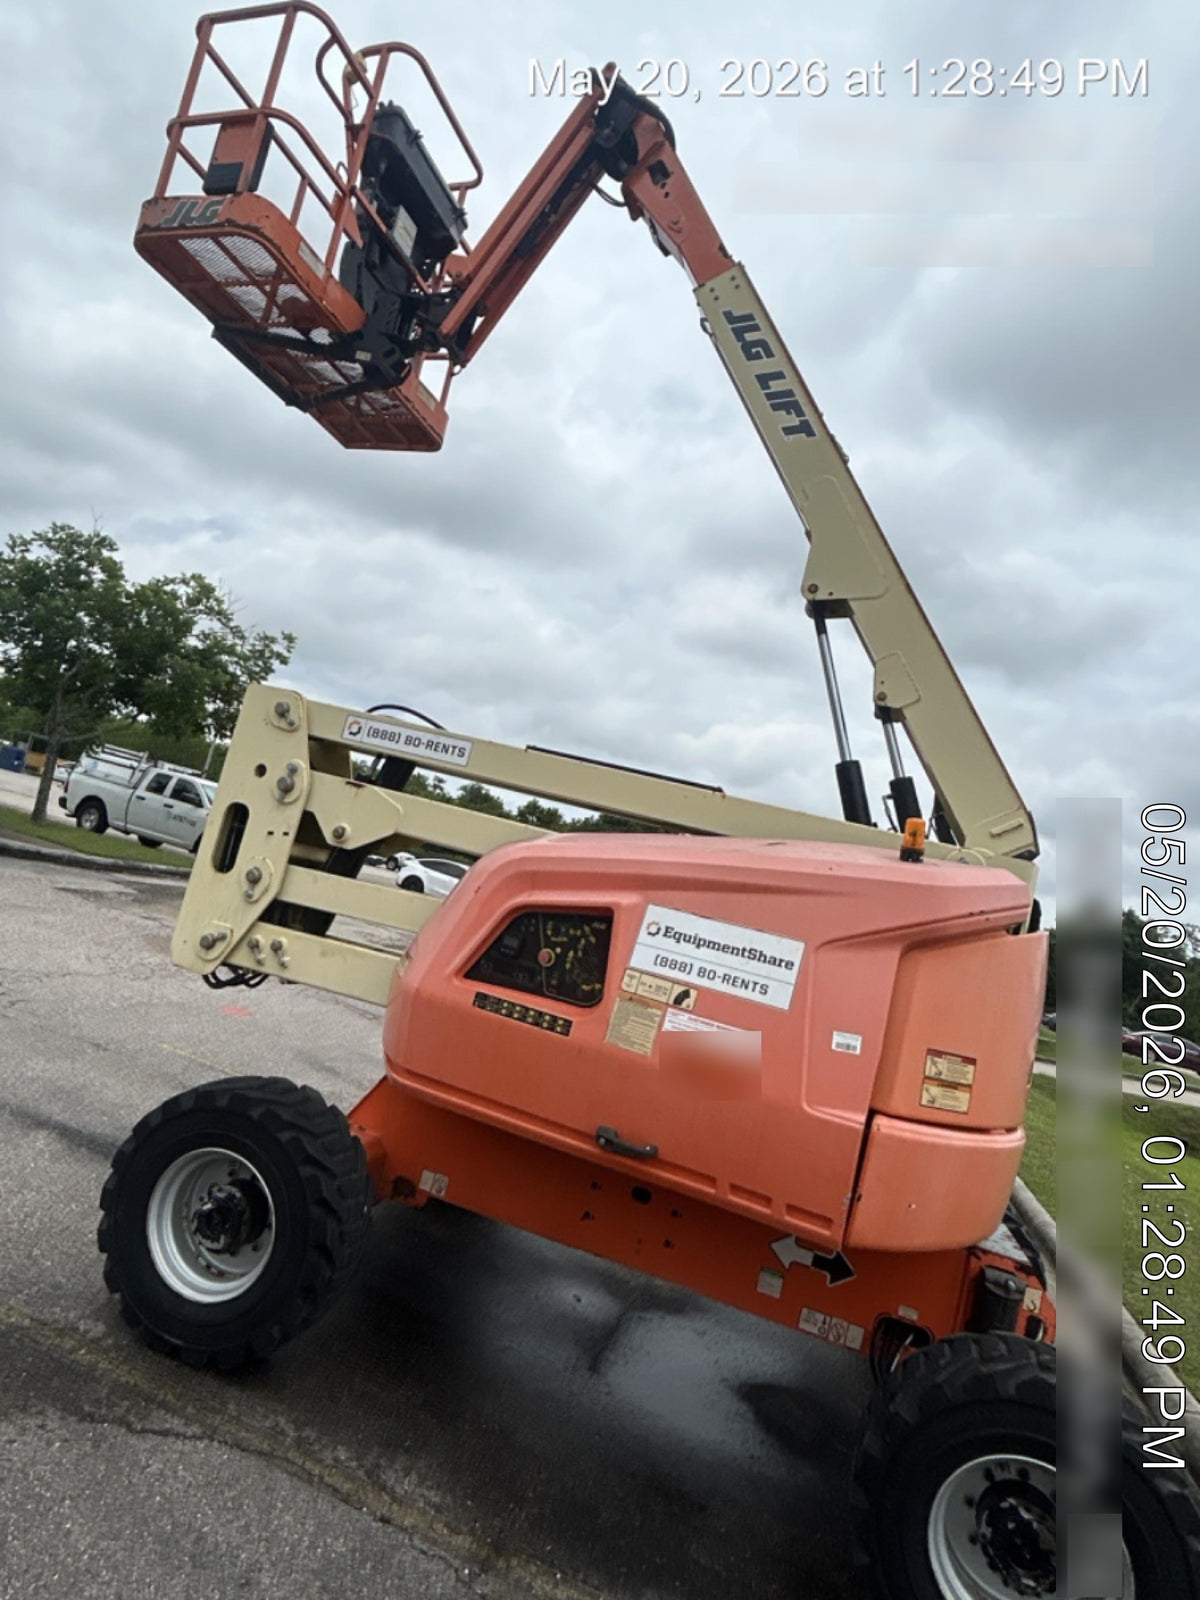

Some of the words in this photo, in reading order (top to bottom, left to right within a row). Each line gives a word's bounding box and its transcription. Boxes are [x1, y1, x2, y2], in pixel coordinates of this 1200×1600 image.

[161, 199, 227, 227] JLG
[722, 309, 776, 362] JLG
[754, 370, 817, 438] LIFT
[366, 726, 402, 745] (888)
[404, 737, 466, 759] 80-RENTS
[662, 925, 795, 971] EquipmentShare
[653, 953, 694, 976] (888)
[697, 967, 770, 996] 80-RENTS
